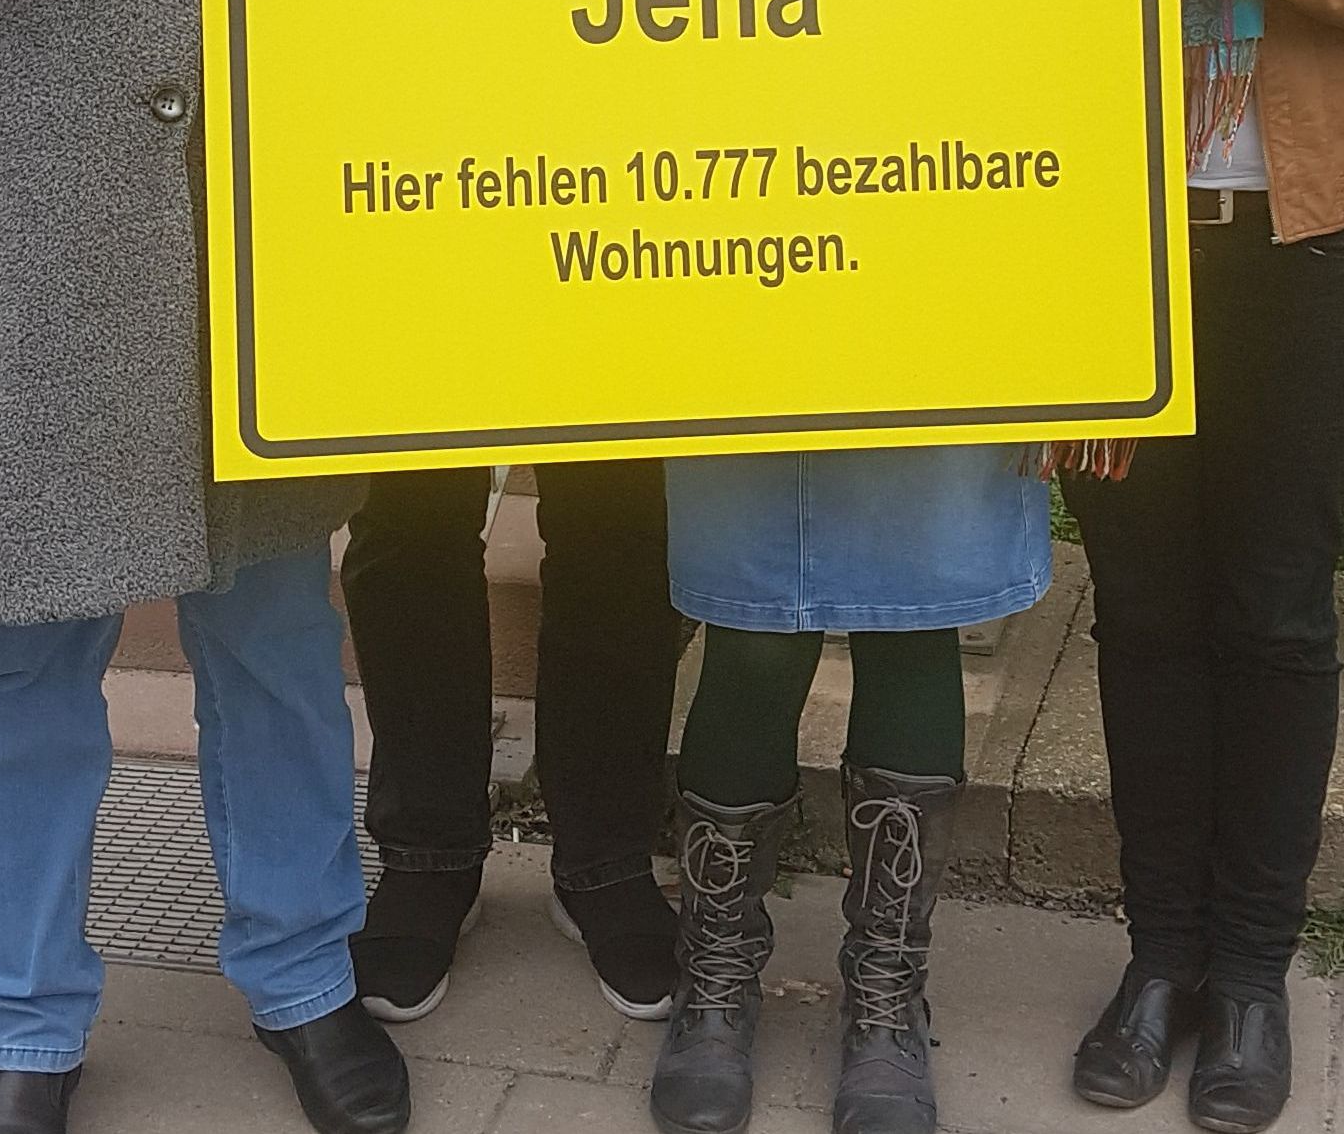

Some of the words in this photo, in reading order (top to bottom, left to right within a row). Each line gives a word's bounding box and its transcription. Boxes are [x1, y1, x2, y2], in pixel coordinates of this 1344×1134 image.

[343, 161, 443, 214] Hier
[457, 155, 607, 209] fehlen
[626, 147, 777, 202] 10.777
[796, 140, 1061, 196] bezahlbare
[550, 228, 859, 288] Wohnungen.
